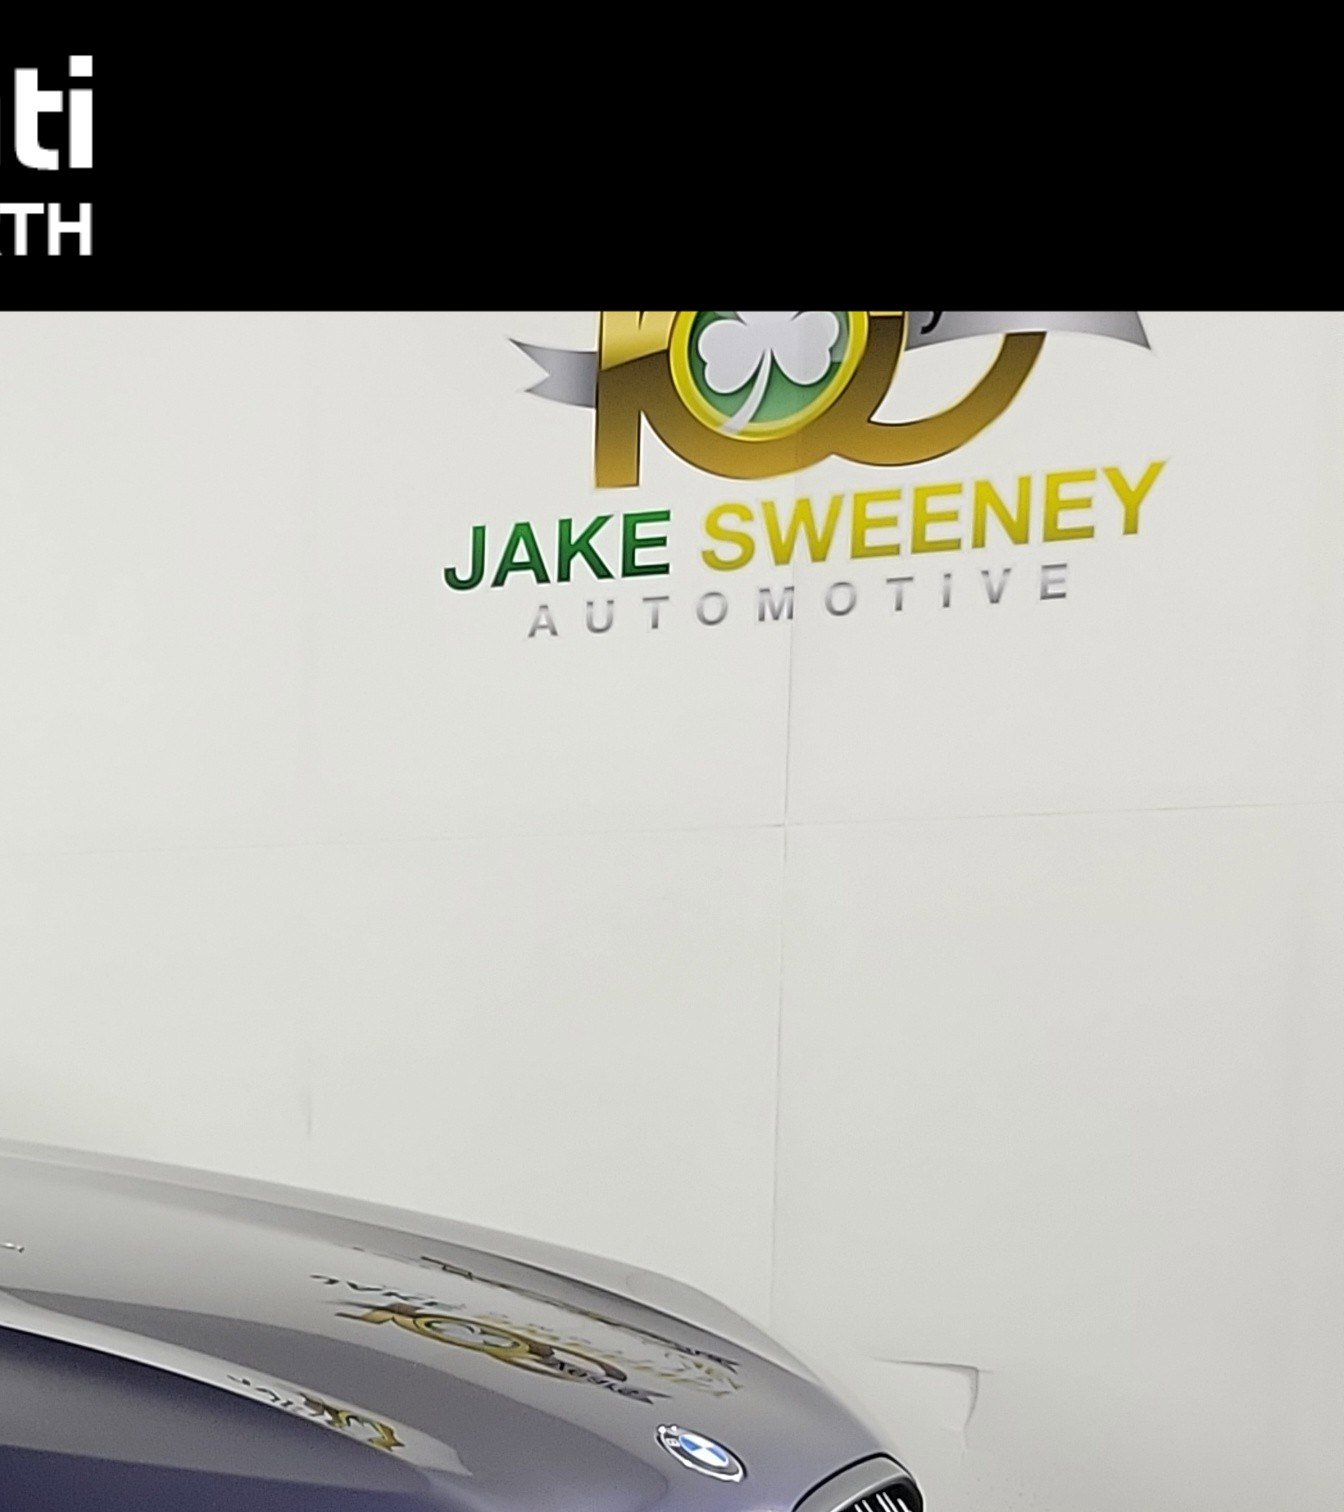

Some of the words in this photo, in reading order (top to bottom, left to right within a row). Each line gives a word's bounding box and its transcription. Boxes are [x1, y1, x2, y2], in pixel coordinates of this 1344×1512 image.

[444, 509, 671, 591] JAKE
[701, 461, 1165, 572] SWEENEY
[528, 563, 1068, 639] AUTOMOTIVE
